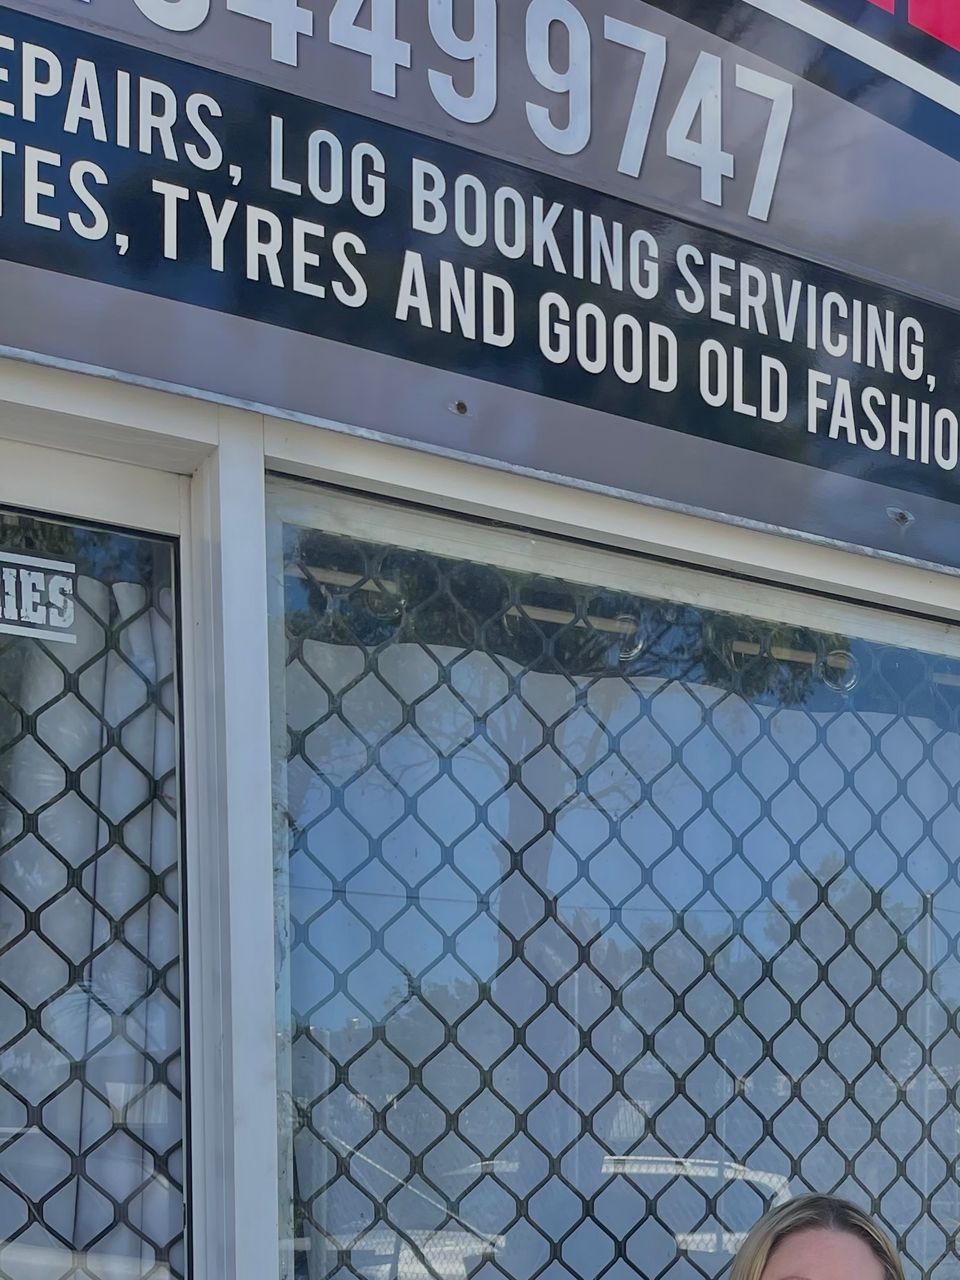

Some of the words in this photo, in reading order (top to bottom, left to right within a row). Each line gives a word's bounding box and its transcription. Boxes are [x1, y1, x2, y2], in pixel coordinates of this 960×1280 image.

[151, 179, 368, 308] TYRES
[395, 250, 515, 348] AND
[539, 292, 678, 393] GOOD
[699, 339, 788, 423] OLD
[271, 115, 386, 218] LOG
[412, 158, 659, 299] BOOKING
[675, 244, 936, 392] SERVICING,
